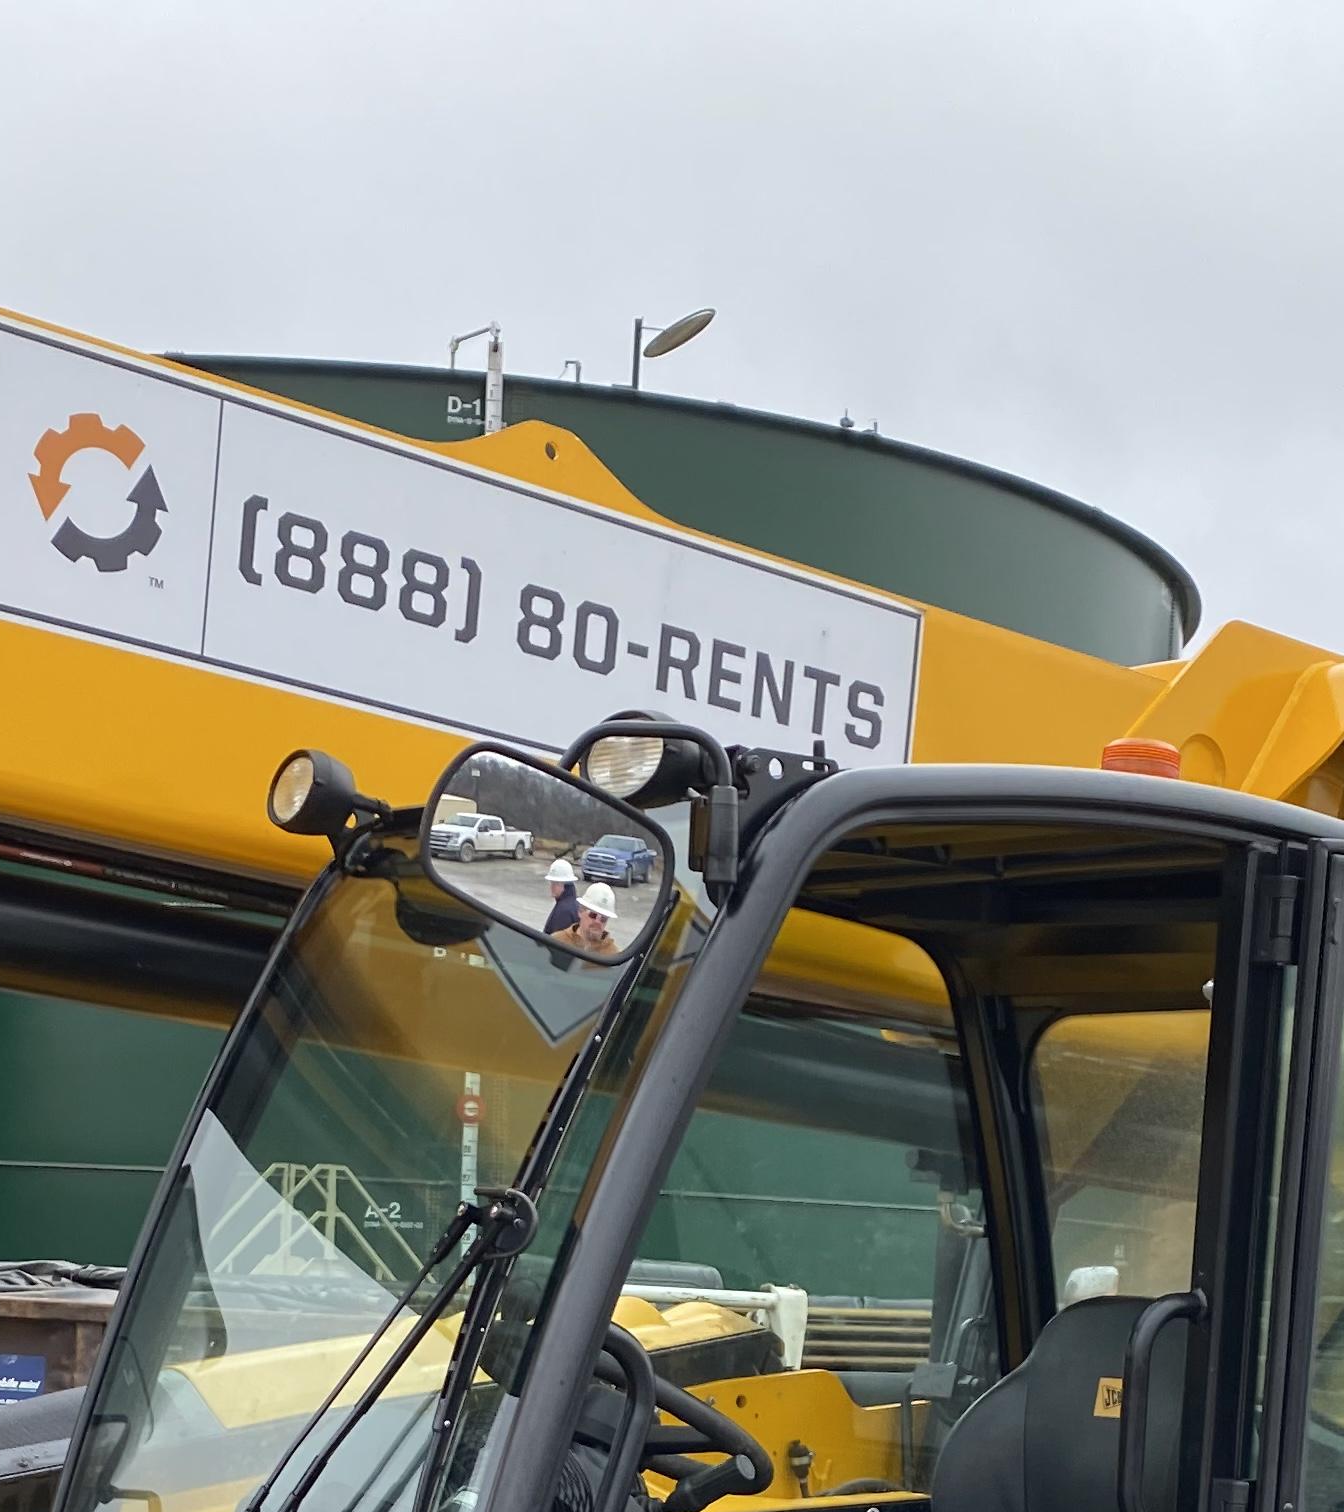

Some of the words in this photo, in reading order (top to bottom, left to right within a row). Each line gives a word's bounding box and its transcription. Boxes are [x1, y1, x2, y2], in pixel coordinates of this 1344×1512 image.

[447, 395, 481, 416] D-1
[239, 494, 482, 643] (888)
[517, 583, 885, 750] 80-RENTS
[364, 1202, 401, 1219] A-2
